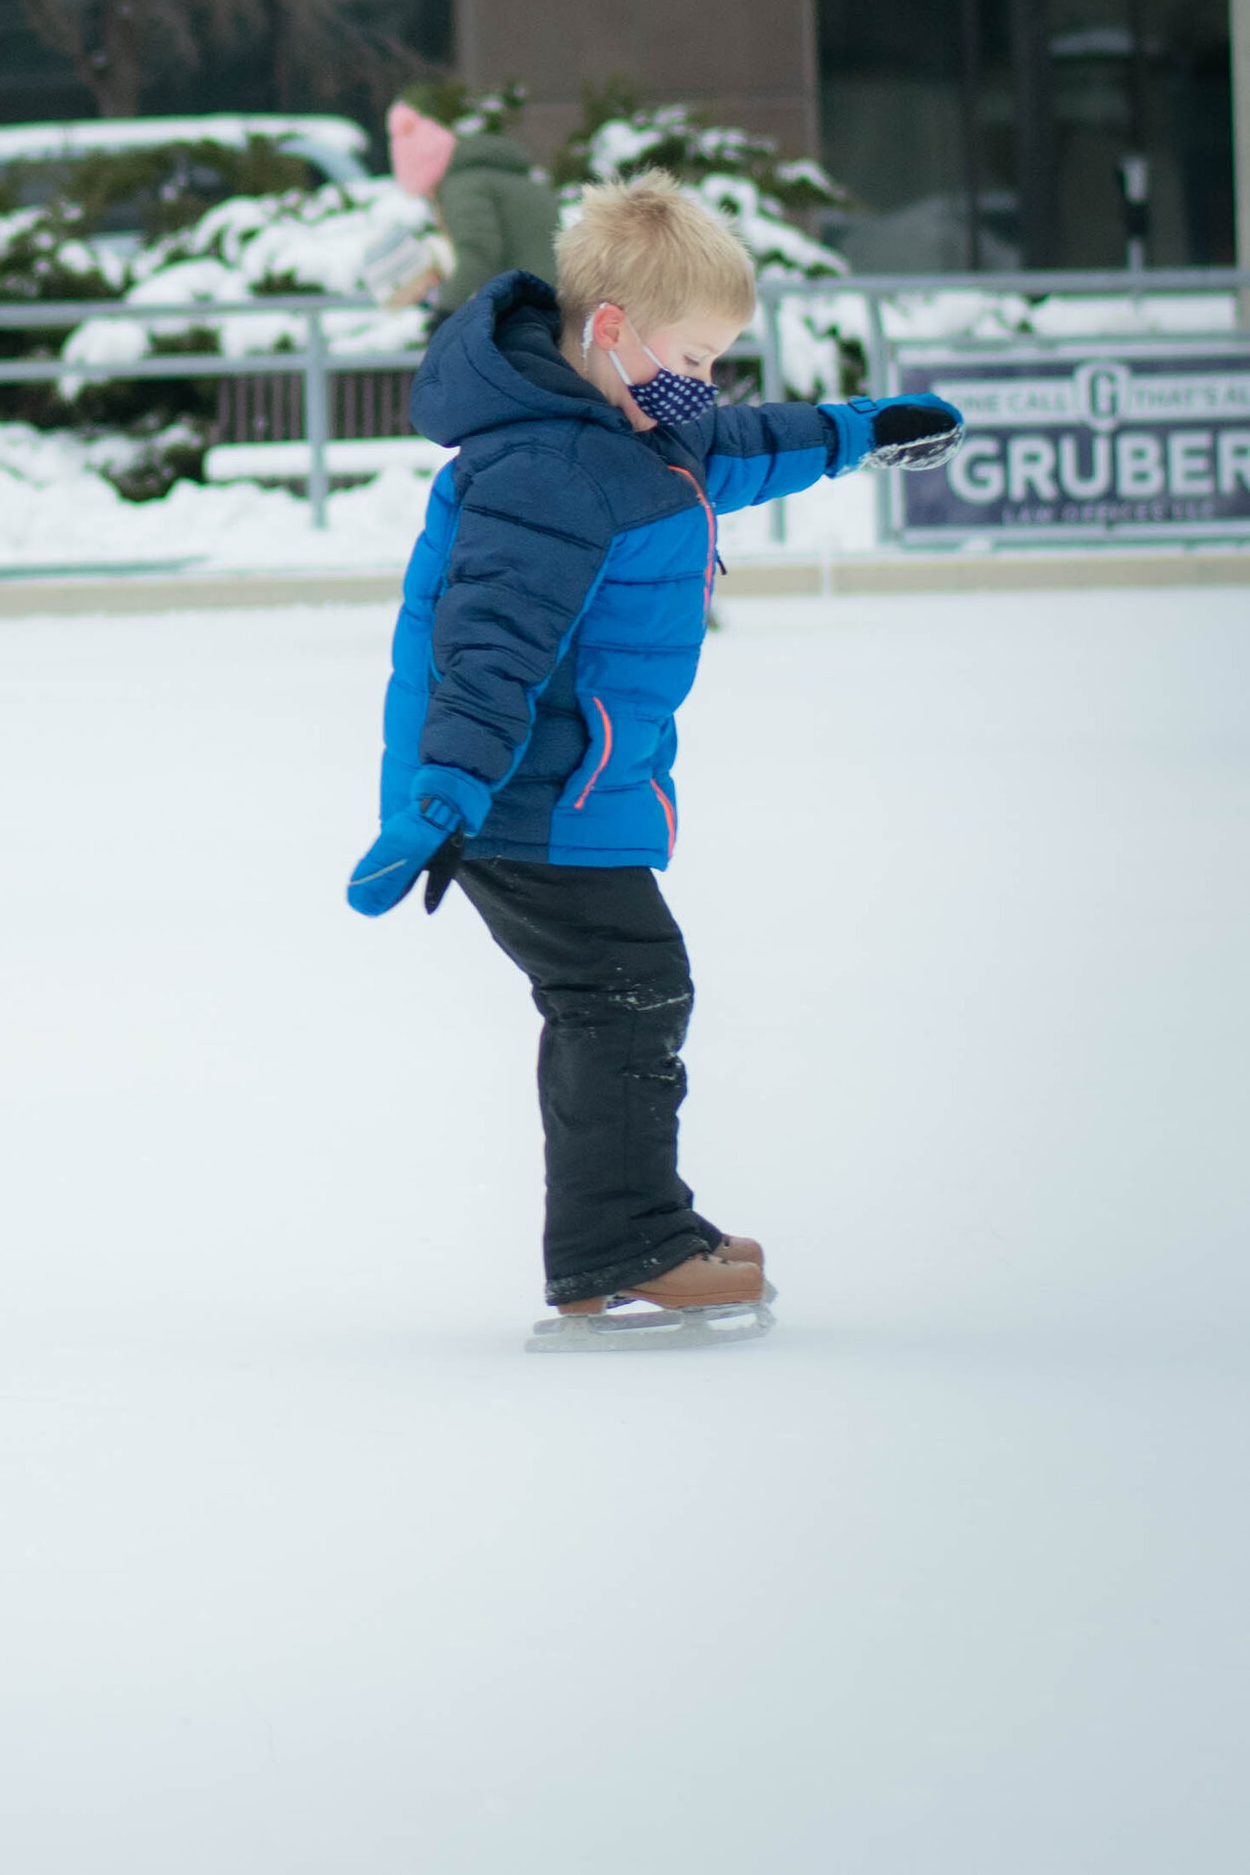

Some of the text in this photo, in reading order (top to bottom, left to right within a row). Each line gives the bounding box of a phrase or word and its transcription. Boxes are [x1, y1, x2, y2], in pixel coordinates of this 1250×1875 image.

[1009, 390, 1067, 412] CALL
[948, 430, 1250, 503] GRUBER
[1002, 505, 1053, 524] LAW
[1062, 502, 1163, 521] OFFICES
